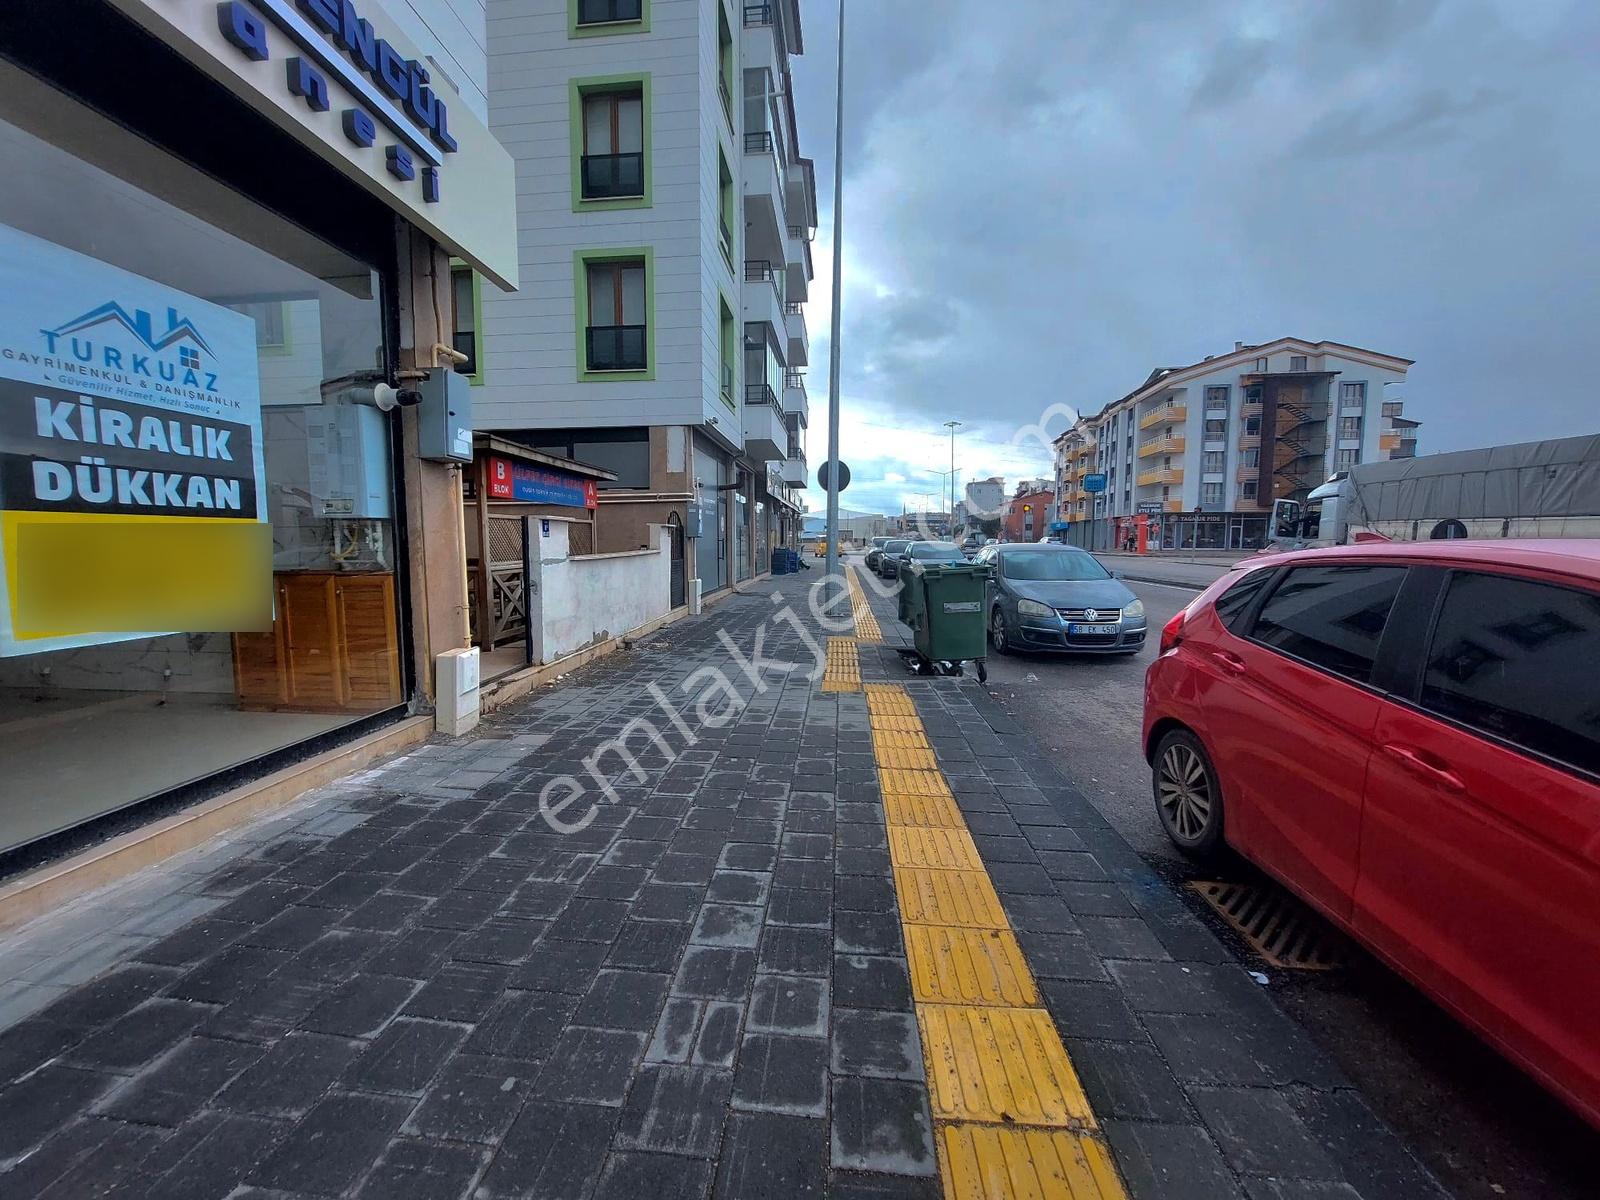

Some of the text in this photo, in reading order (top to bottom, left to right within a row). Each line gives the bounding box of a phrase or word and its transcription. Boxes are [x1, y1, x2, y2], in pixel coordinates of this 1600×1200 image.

[2, 348, 132, 386] GAYRİMENKUL
[155, 383, 241, 409] DANIŞMANLIK
[40, 328, 219, 393] TURKUAZ
[58, 374, 113, 392] Güvenilir
[34, 395, 233, 461] KİRALIK
[32, 456, 241, 510] DÜKKAN
[493, 483, 510, 494] BLOK
[497, 461, 505, 480] B
[588, 483, 594, 496] A
